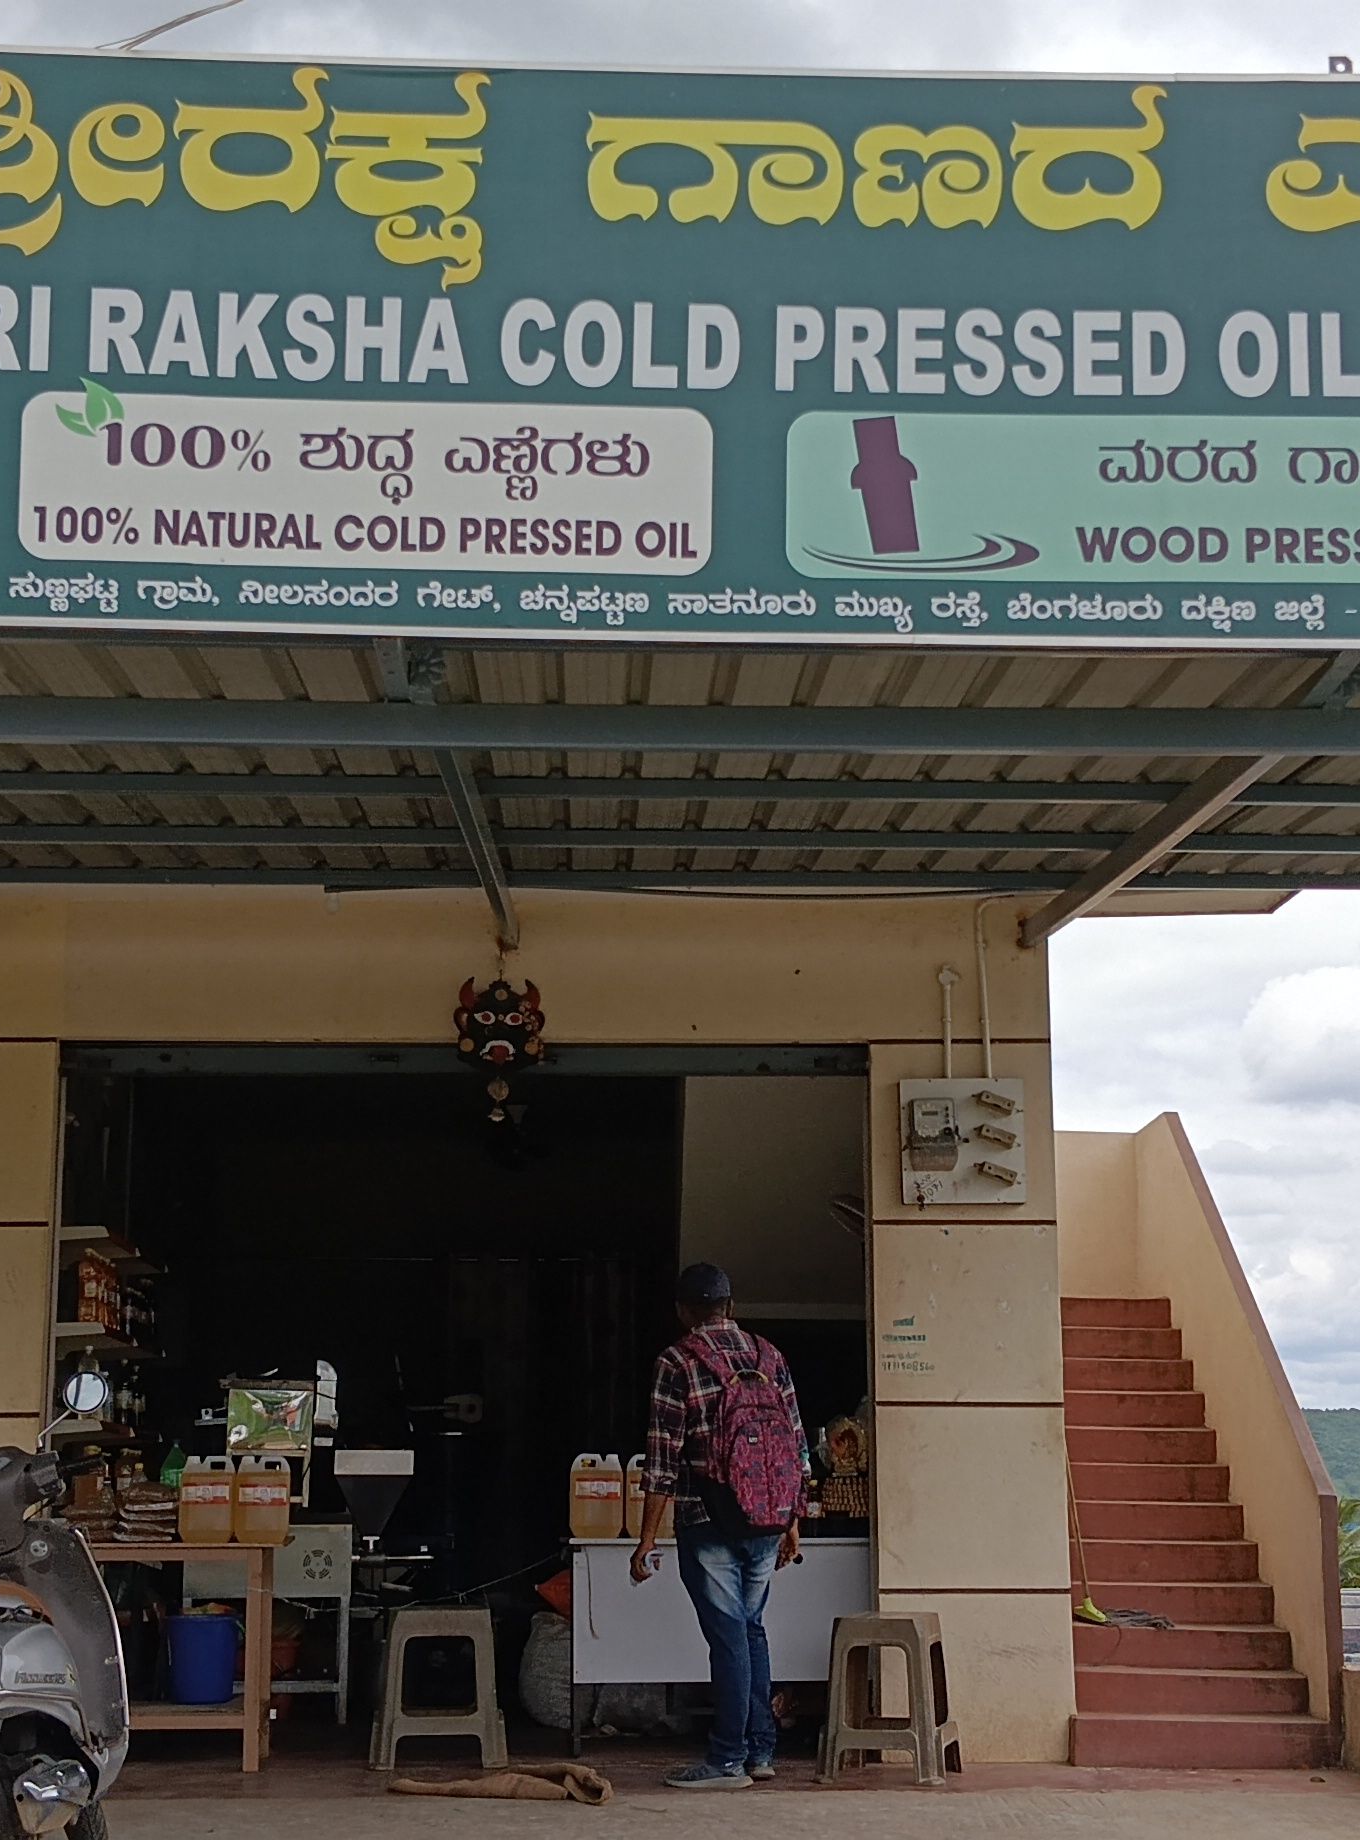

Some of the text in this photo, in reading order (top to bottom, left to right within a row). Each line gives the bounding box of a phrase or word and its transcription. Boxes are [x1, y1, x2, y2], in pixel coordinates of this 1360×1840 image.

[587, 84, 1167, 231] ಗಾಣದ
[88, 290, 469, 386] RAKSHA
[500, 297, 741, 390] COLD
[774, 305, 1186, 397] PRESSED
[100, 421, 650, 505] 100% ಶುದ್ಧ ಎಣ್ಣೆಗಳು
[1098, 438, 1258, 484] ಮರದ
[33, 505, 698, 559] 100% NATURAL COLD PRESSED OIL
[1075, 525, 1229, 564] WOOD
[136, 575, 220, 610] ಗ್ರಾಮ,
[238, 578, 399, 607] ನೀಲಸಂದರ
[416, 580, 501, 613] ಗೇಟ್,
[519, 583, 650, 626] ಚನ್ನಪಟ್ಟಣ
[667, 587, 817, 616] ಸಾತನೂರು
[834, 590, 914, 633] ಮುಖ್ಯ
[930, 591, 989, 627] ರಸ್ತೆ,
[1006, 592, 1163, 621] ಬೆಂಗಳೂರು
[1180, 593, 1257, 633] ದಕ್ಷಿಣ
[1274, 593, 1325, 631] ಜಿಲ್ಲೆ
